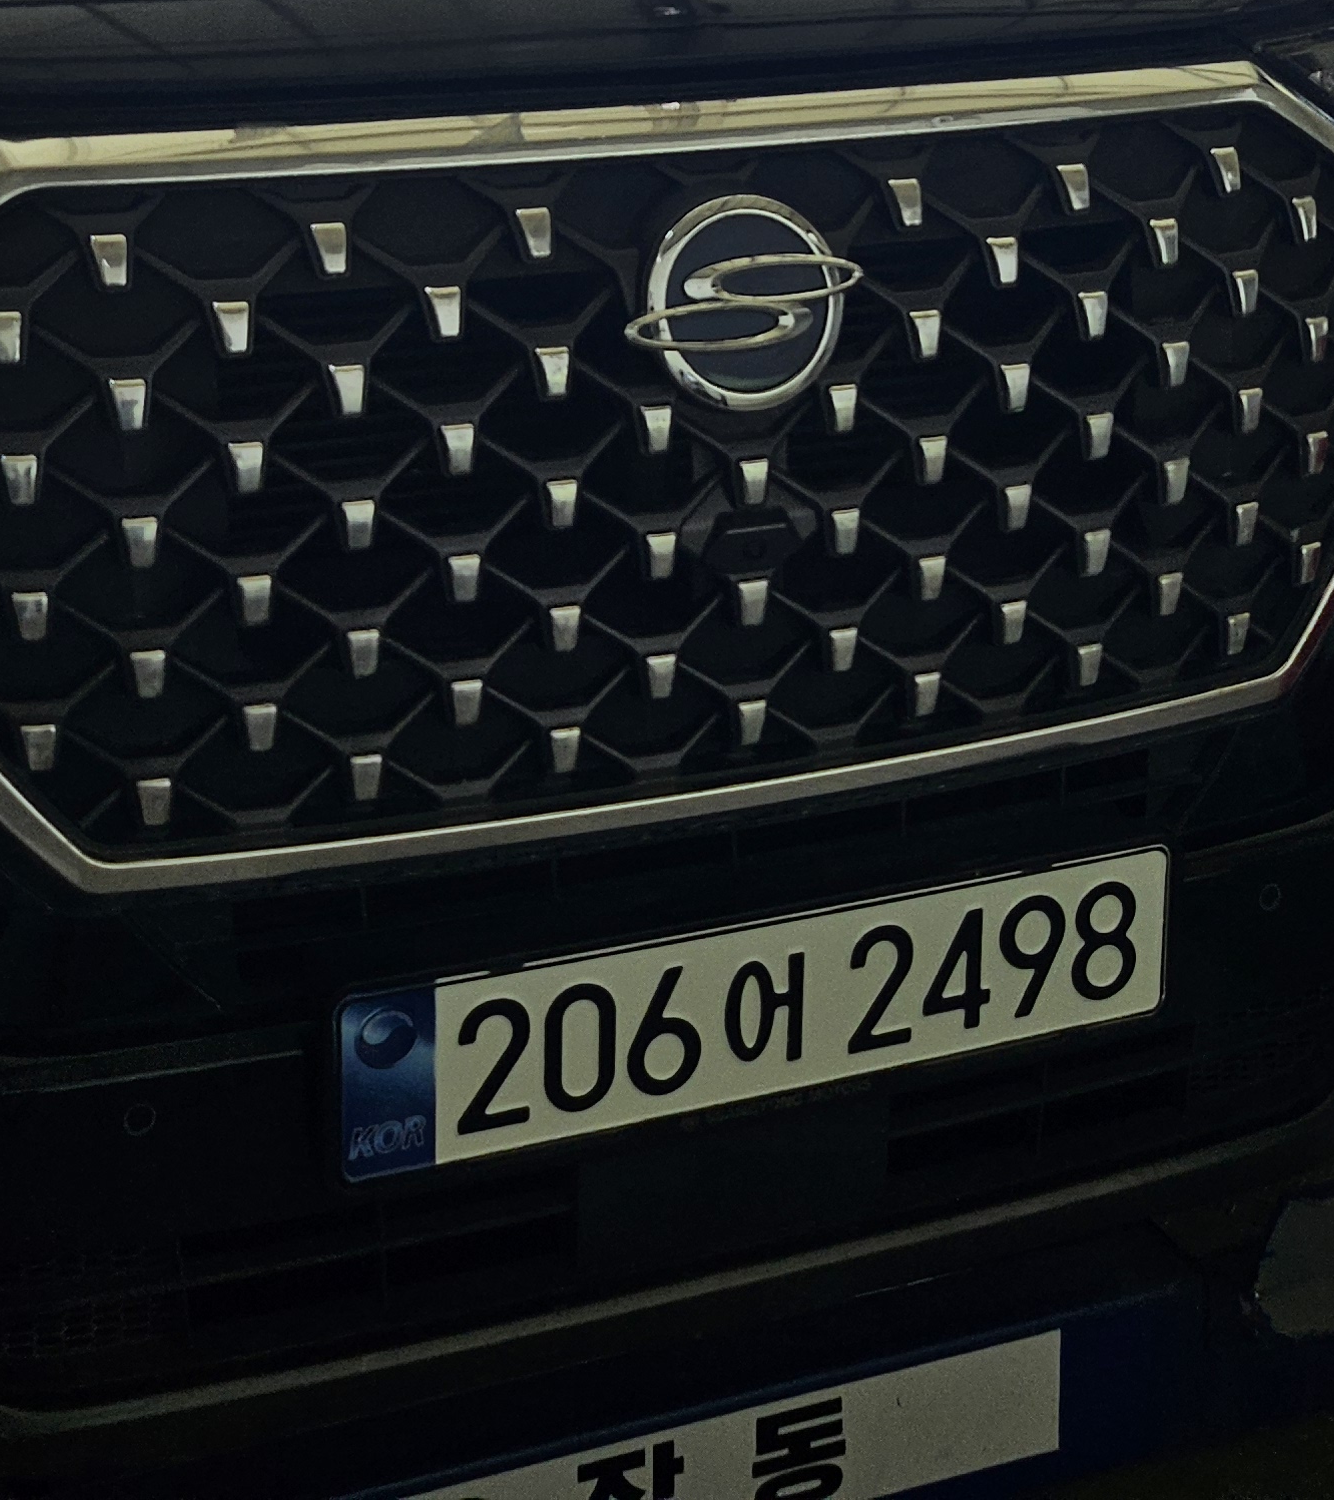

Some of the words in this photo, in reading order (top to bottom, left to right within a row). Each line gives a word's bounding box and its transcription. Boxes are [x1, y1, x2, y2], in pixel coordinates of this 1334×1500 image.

[455, 951, 807, 1136] 206어
[846, 879, 1138, 1056] 2498
[348, 1114, 427, 1161] KOR
